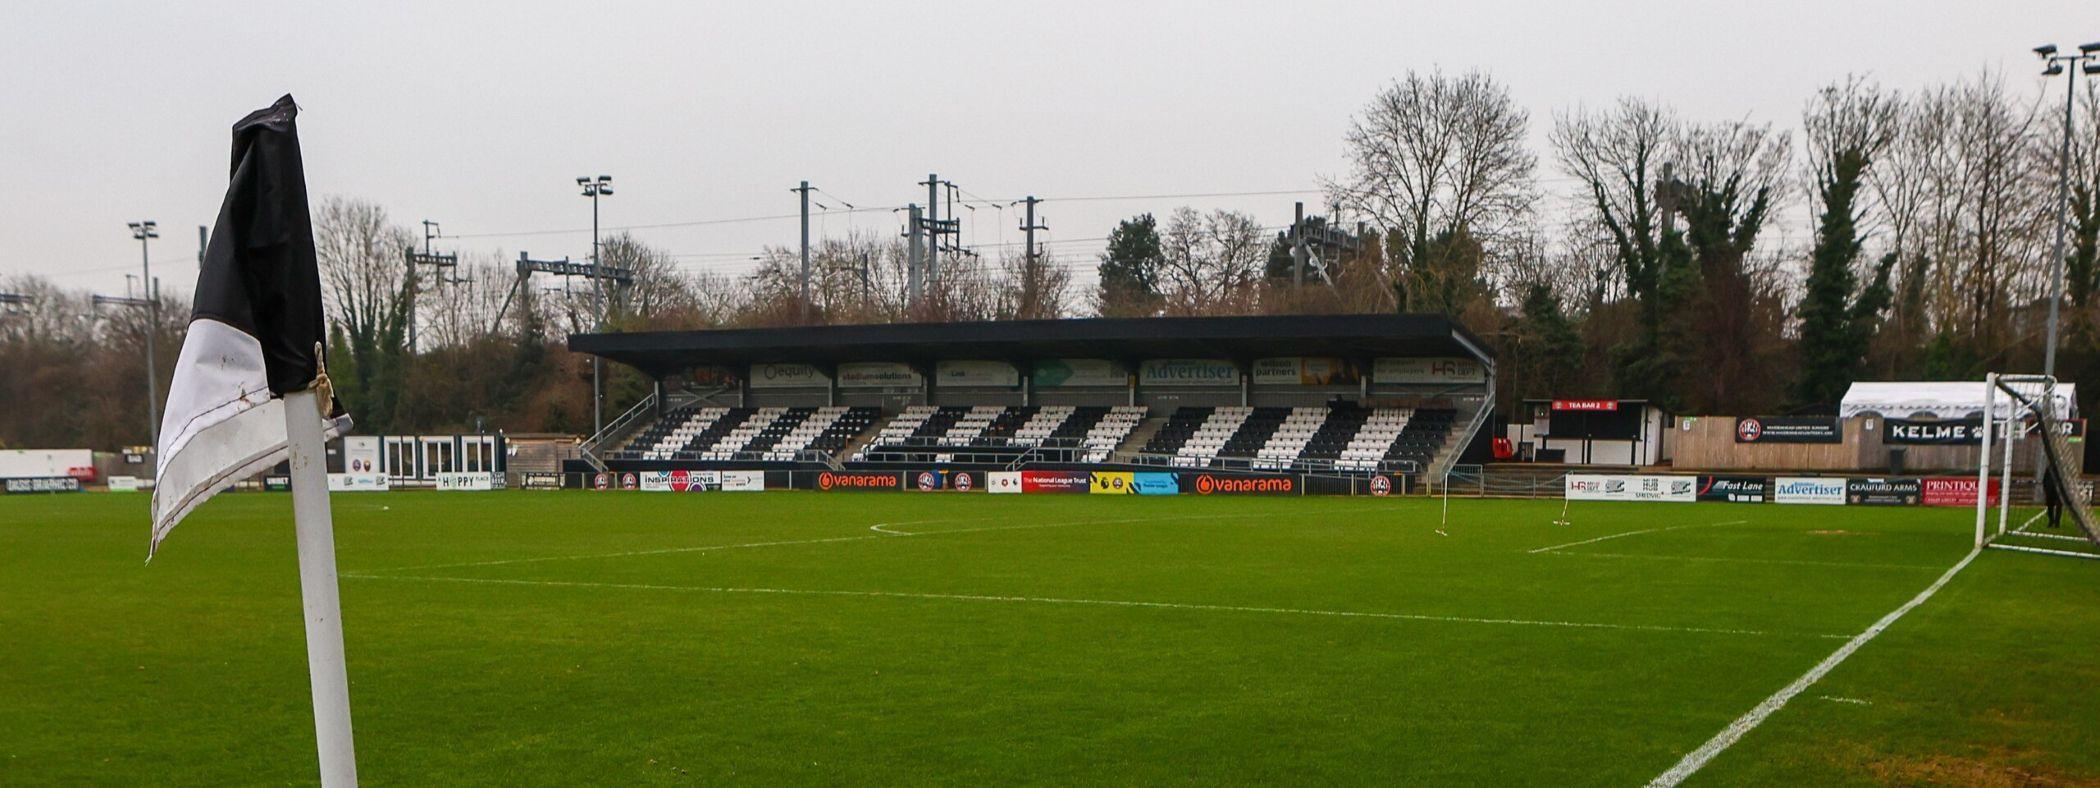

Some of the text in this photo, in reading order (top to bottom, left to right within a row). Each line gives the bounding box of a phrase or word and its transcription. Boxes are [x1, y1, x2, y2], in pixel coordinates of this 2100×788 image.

[778, 365, 815, 378] equity
[1147, 363, 1233, 379] Advertiser
[1892, 425, 1966, 439] KELME
[834, 473, 896, 487] vanarama
[1055, 477, 1073, 485] League
[1214, 477, 1292, 491] vanarama
[1722, 480, 1763, 490] Fast Lane
[1778, 482, 1843, 495] Advertiser
[1893, 484, 1917, 492] ARMS
